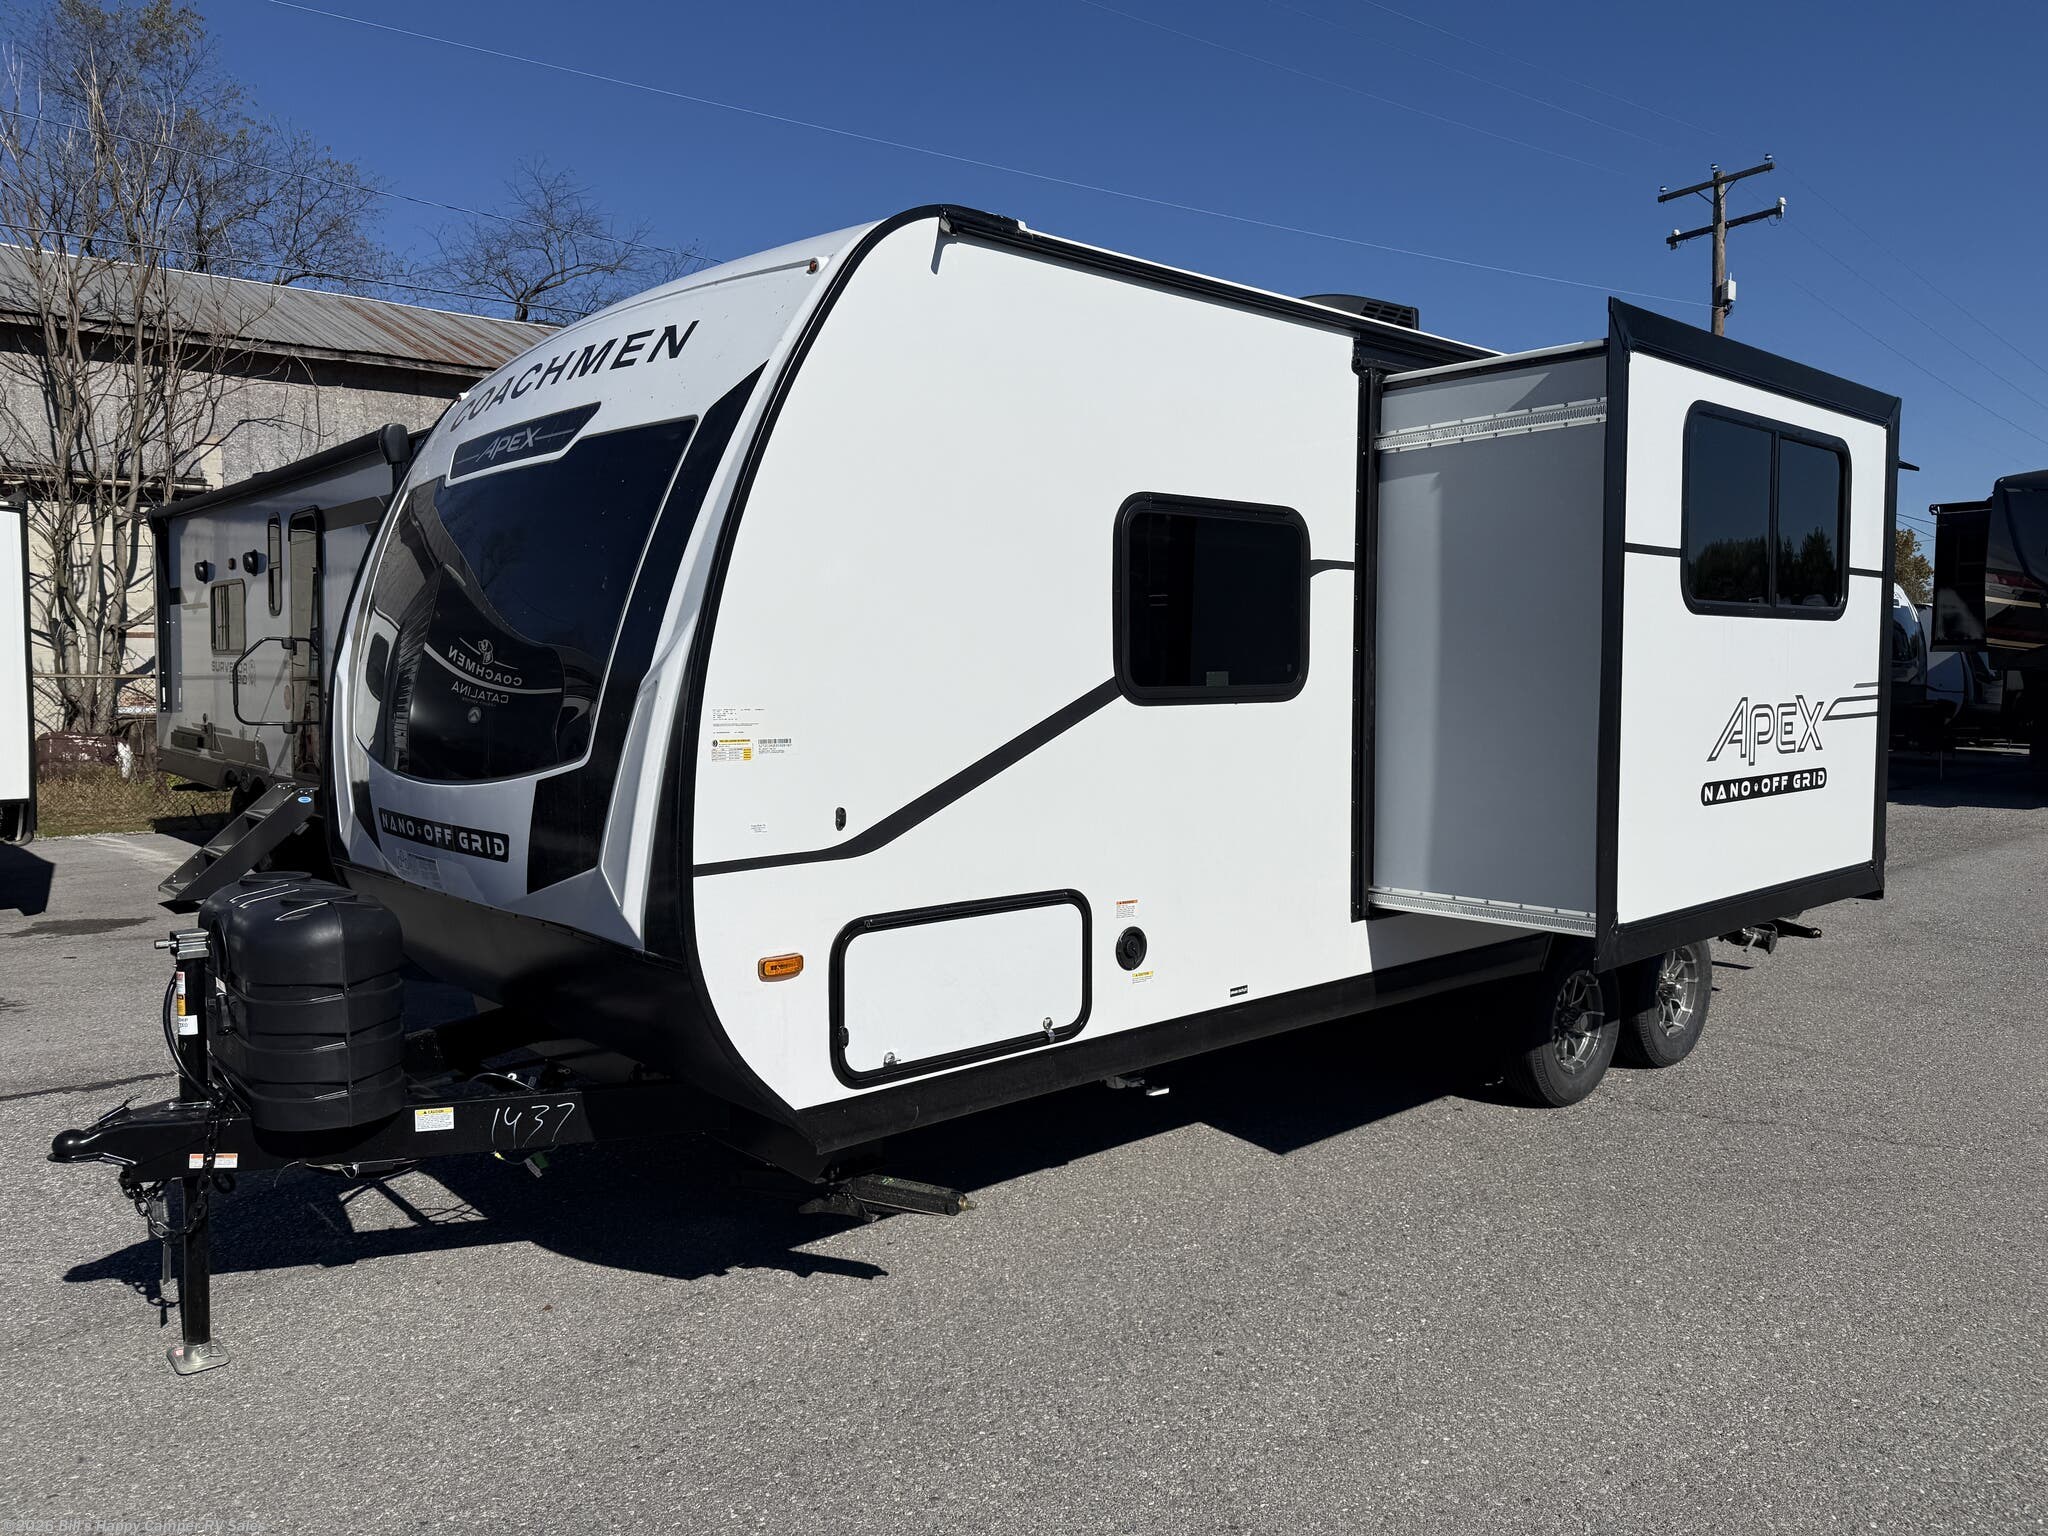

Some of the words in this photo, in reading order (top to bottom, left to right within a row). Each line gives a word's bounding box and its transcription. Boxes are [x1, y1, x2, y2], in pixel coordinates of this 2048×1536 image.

[450, 319, 700, 432] COACHMEN
[476, 427, 544, 463] APEX
[1706, 694, 1825, 766] APEX
[1704, 780, 1751, 802] NANO
[1761, 775, 1789, 794] OFF
[1793, 770, 1826, 788] GRID
[381, 812, 415, 837] NANO
[423, 823, 452, 847] OFF
[458, 834, 505, 856] GRID
[491, 1102, 576, 1149] 1437
